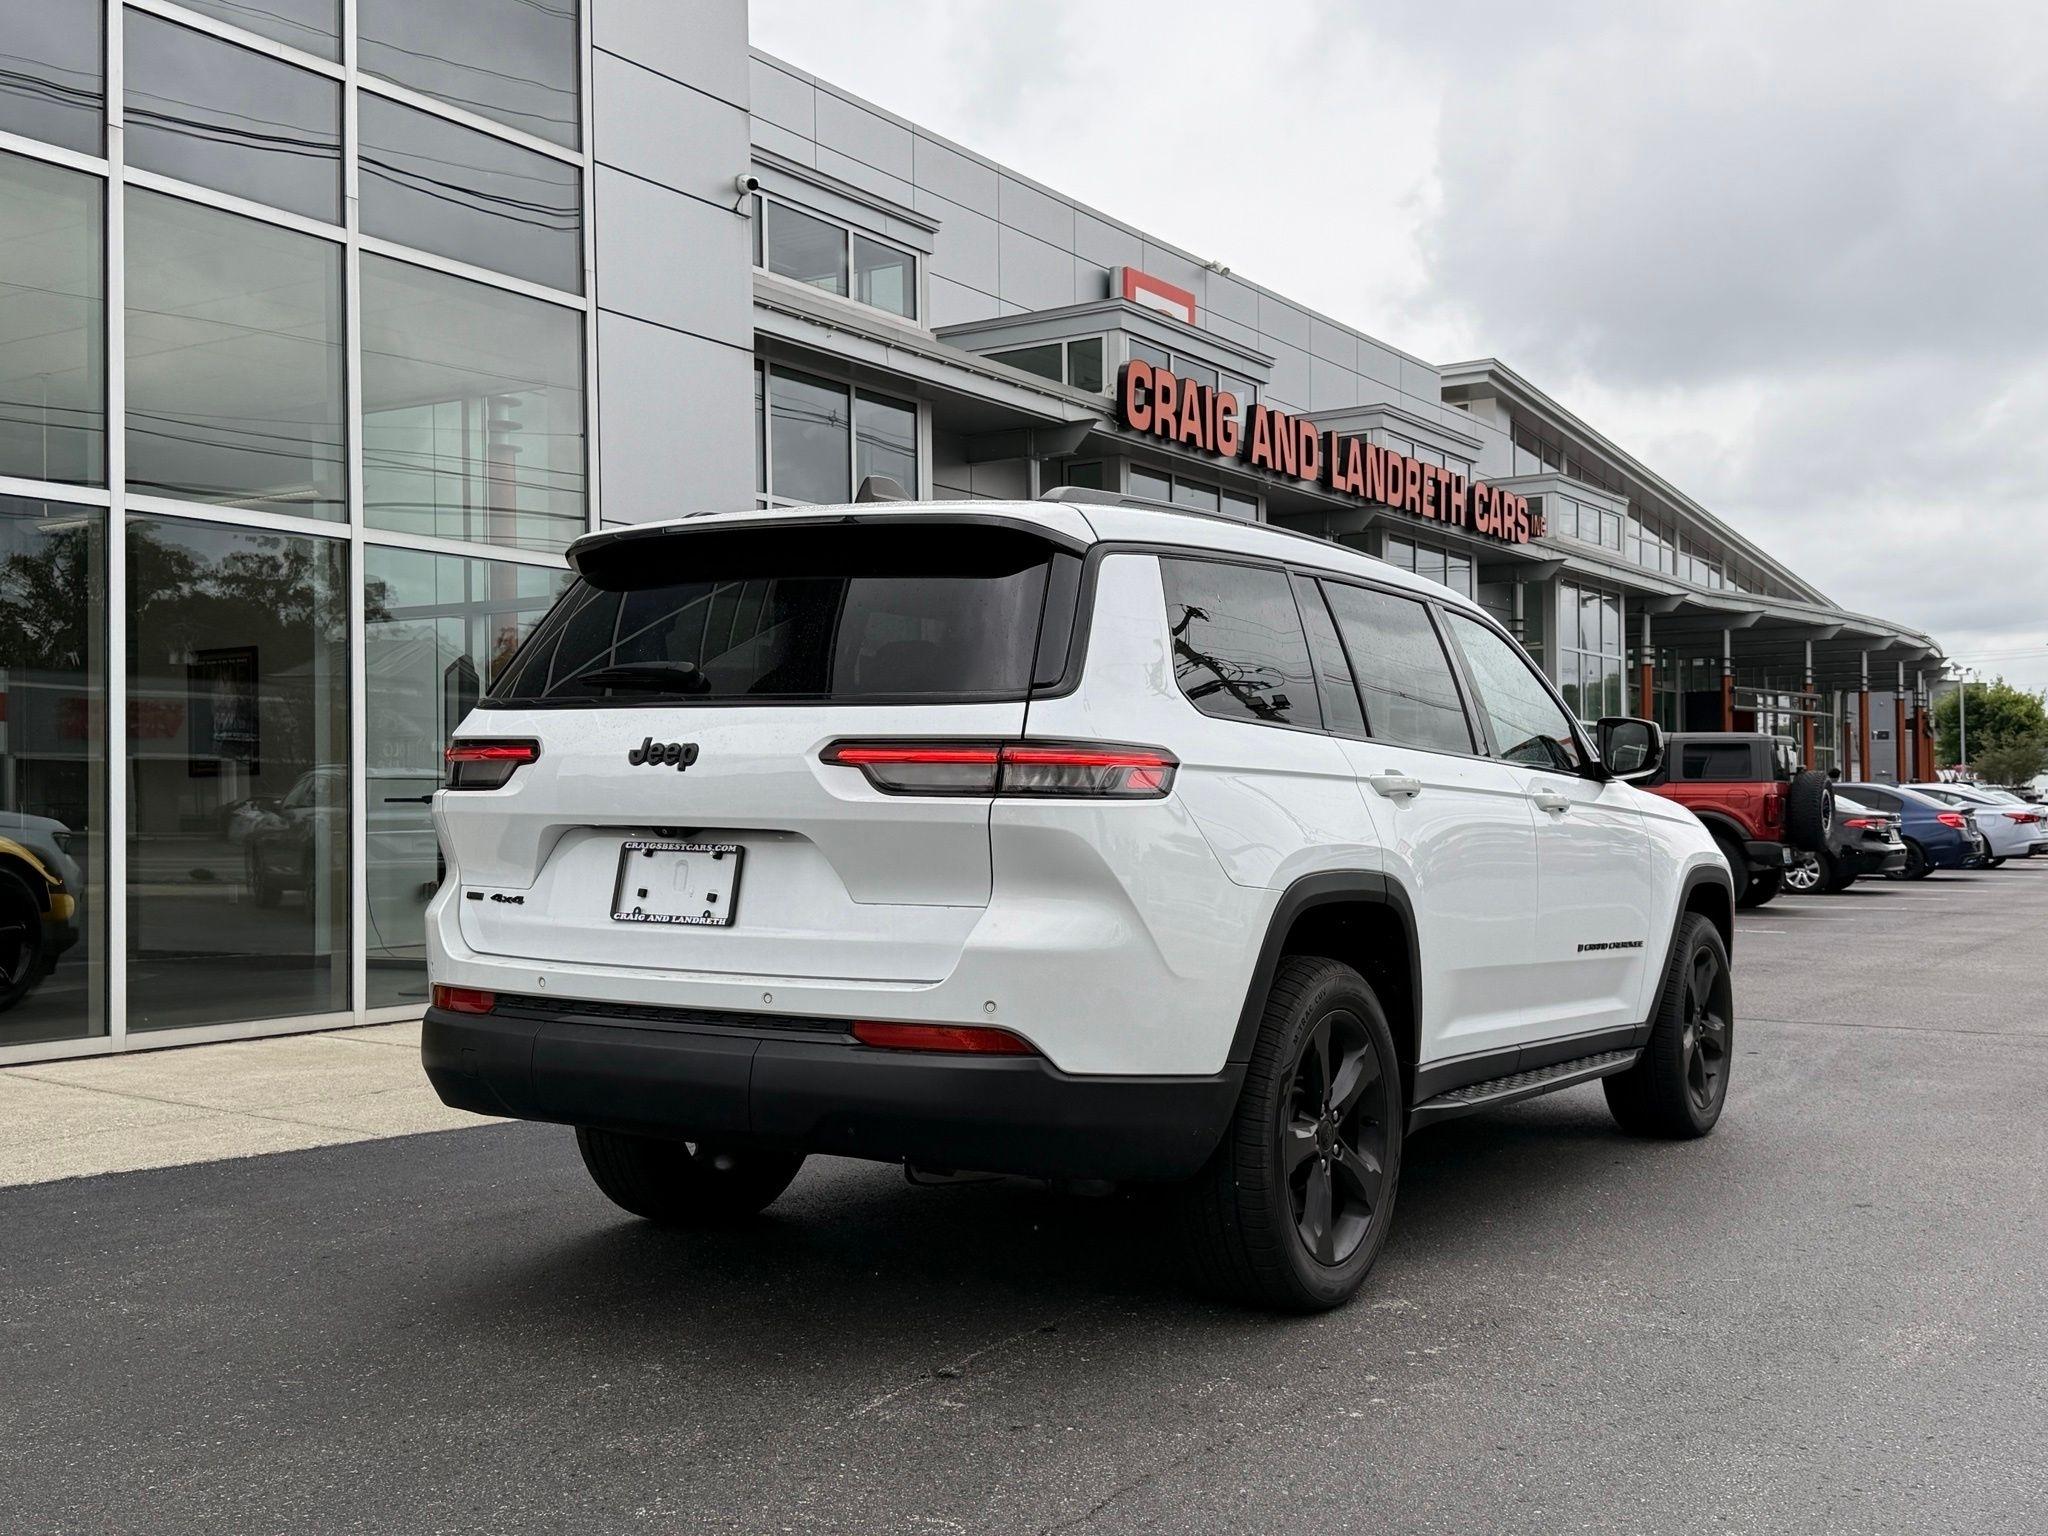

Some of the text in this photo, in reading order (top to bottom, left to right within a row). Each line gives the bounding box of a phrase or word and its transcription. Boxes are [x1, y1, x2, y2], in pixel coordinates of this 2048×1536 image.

[1121, 358, 1239, 458] CRAIG
[1247, 403, 1319, 482] AND
[1327, 430, 1467, 526] LANDRETH
[1472, 481, 1530, 545] CARS
[628, 737, 700, 772] Jeep
[624, 841, 738, 853] CRAIGSBESTCARS.COM
[613, 912, 727, 926] CRAIG AND LANDRETH
